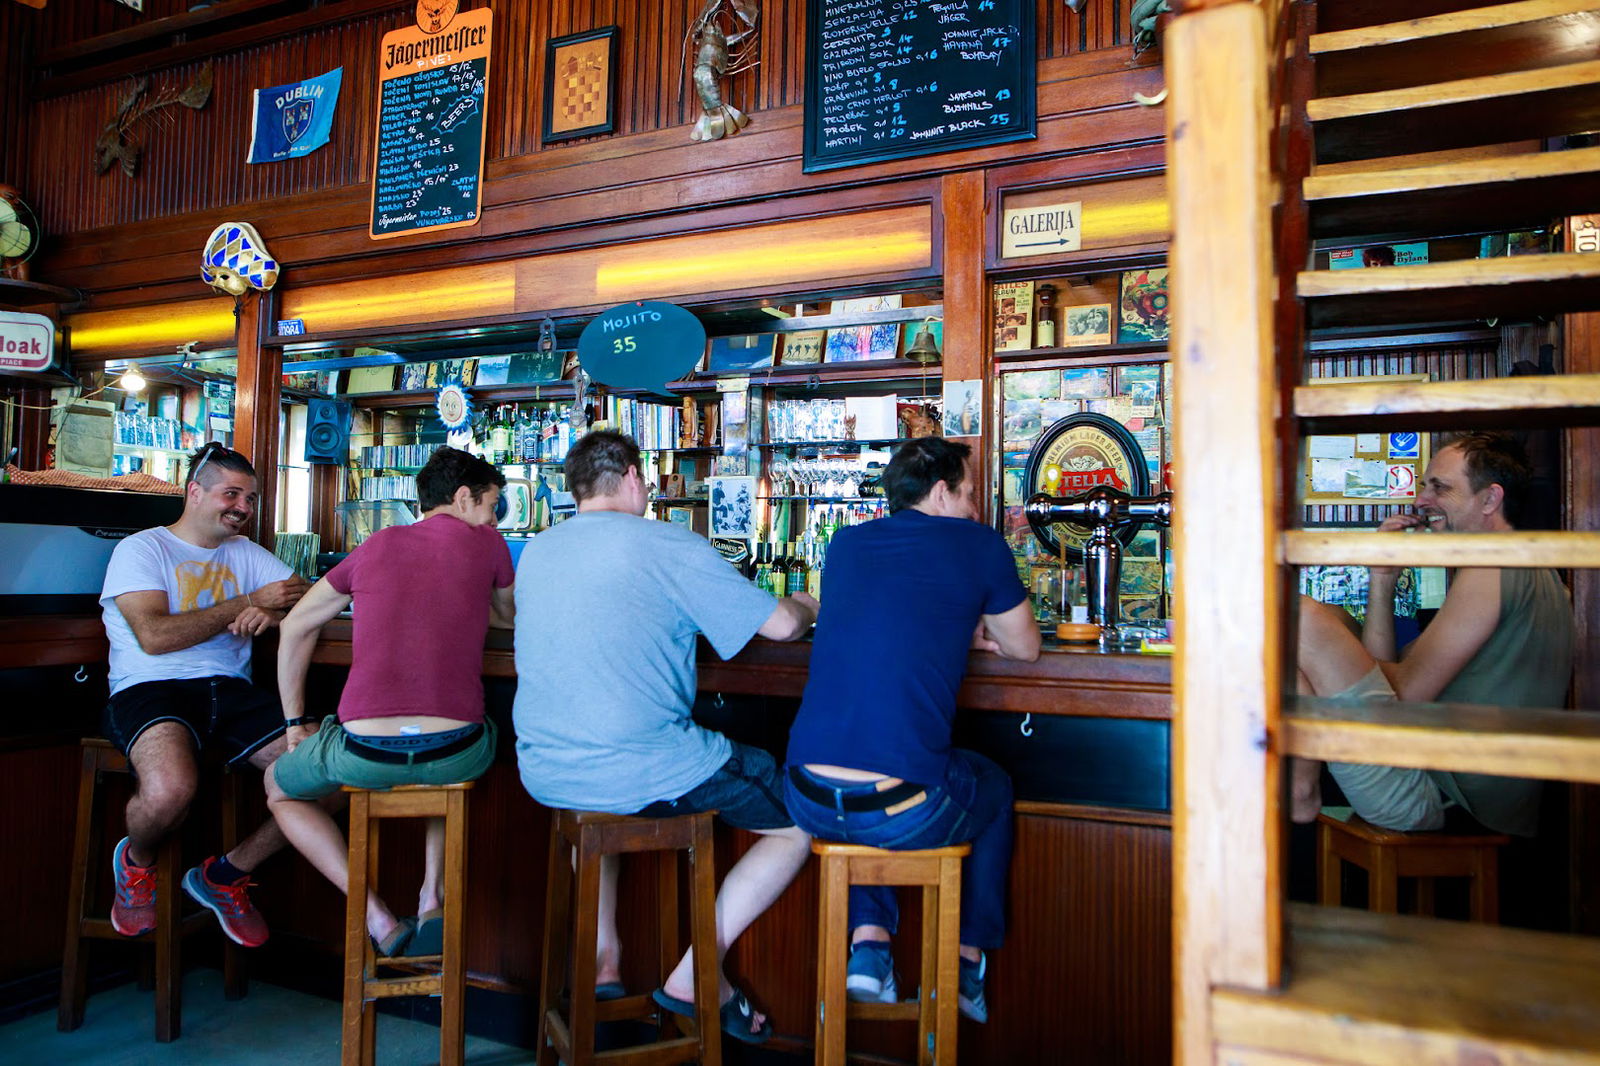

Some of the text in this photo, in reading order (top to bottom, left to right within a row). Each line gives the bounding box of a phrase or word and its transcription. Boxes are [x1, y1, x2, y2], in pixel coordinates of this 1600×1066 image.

[902, 10, 918, 20] 12
[928, 0, 968, 13] TEQUILA
[824, 8, 885, 29] SENZACIJA
[386, 25, 486, 70] Jägermeister
[822, 32, 876, 50] CEDEVITA
[824, 34, 914, 60] GAZIRANI SOK 14
[943, 37, 1012, 52] HAVANA 17
[822, 46, 912, 72] PRIRODNI SOK 14
[960, 50, 1002, 66] BOMBAY
[824, 73, 844, 83] VINO
[877, 57, 911, 68] STOLNO
[872, 72, 882, 84] 8
[888, 78, 898, 90] 8
[276, 84, 324, 109] DUBLIN
[824, 104, 844, 114] VINO
[847, 98, 870, 110] CRNO
[874, 88, 912, 104] MERLOT
[930, 81, 938, 92] 6
[948, 89, 986, 102] JAMESON
[441, 98, 474, 129] BEERS
[948, 120, 986, 132] BLACK
[990, 113, 1010, 125] 25
[824, 123, 867, 137] PROŠEK
[892, 114, 907, 126] 12
[429, 138, 440, 146] 25
[826, 135, 862, 148] MARTINI
[890, 128, 904, 138] 20
[442, 144, 454, 153] 25
[413, 160, 422, 168] 16
[449, 164, 459, 172] 23
[1010, 210, 1074, 236] GALERIJA
[603, 310, 662, 333] MOJITO
[614, 336, 637, 354] 35
[715, 541, 737, 552] GUINNESS
